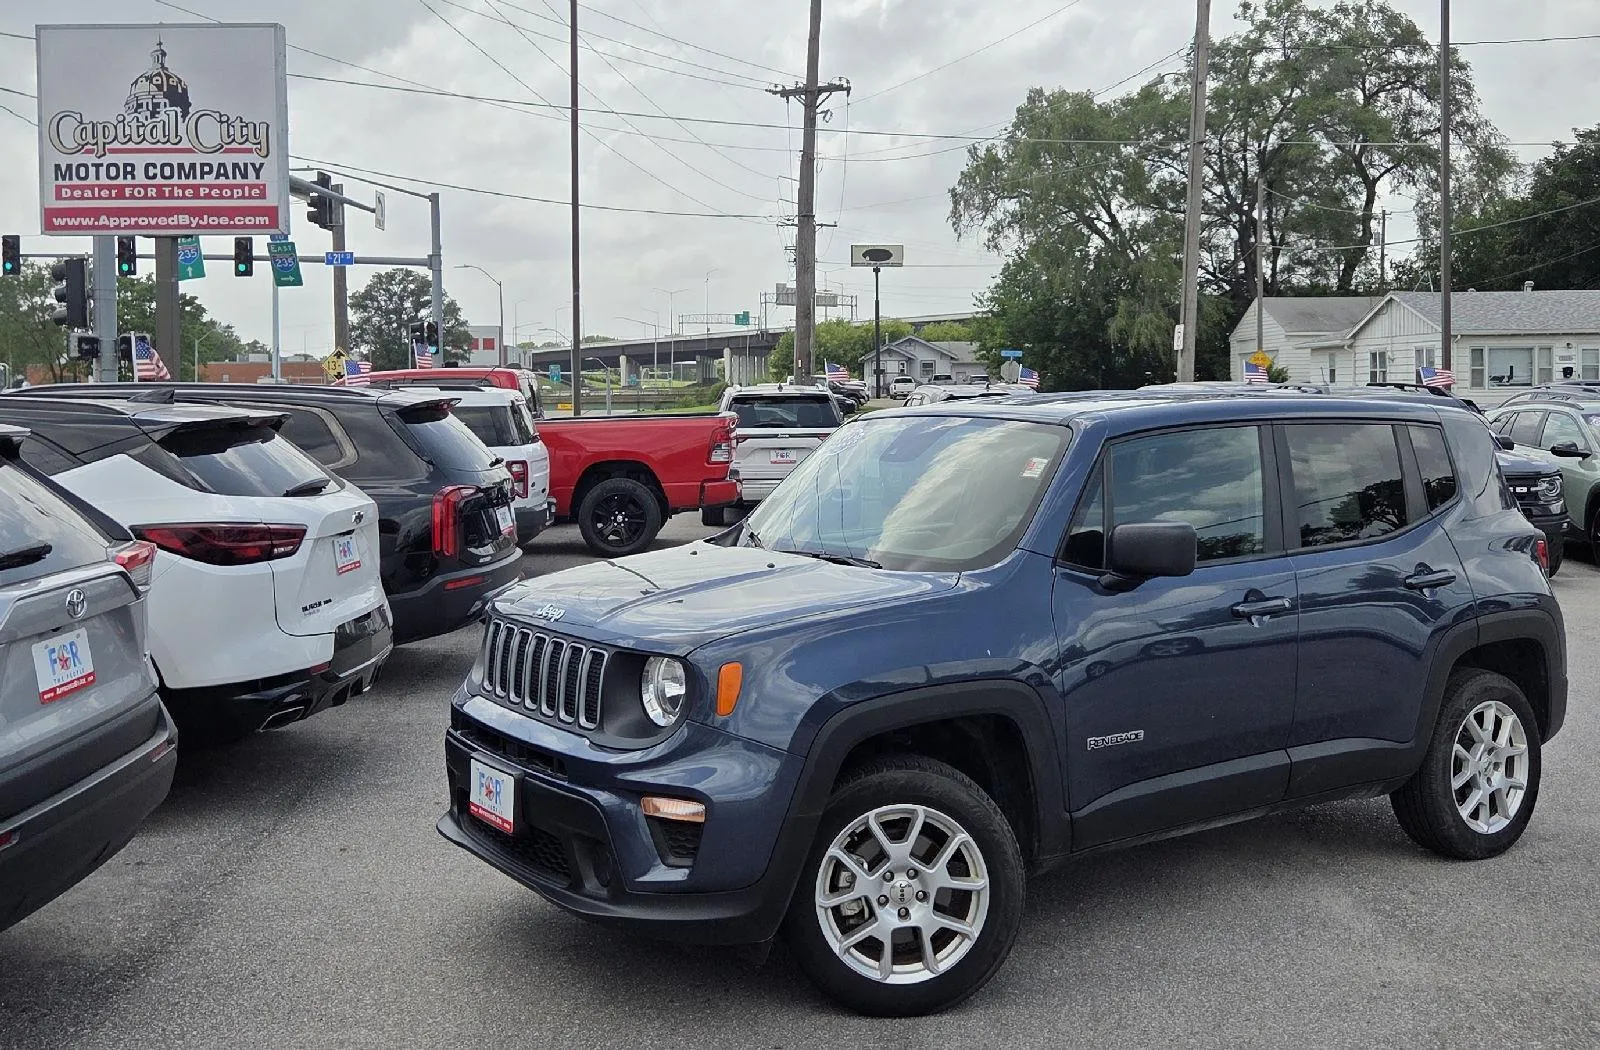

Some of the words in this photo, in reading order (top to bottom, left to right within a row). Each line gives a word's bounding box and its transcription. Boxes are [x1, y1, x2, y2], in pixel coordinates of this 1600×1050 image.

[49, 109, 183, 159] Capital
[186, 109, 269, 158] City
[54, 163, 136, 181] MOTOR
[144, 162, 265, 180] COMPANY
[62, 187, 118, 198] Dealer
[125, 187, 157, 197] FOR
[162, 186, 194, 197] The
[199, 185, 261, 198] People
[52, 214, 270, 228] www.ApprovedByJoe.com
[178, 249, 198, 260] 235
[275, 257, 295, 267] 235
[536, 603, 566, 623] Jeep
[47, 640, 82, 676] FOR
[1086, 729, 1144, 751] RENEGADE
